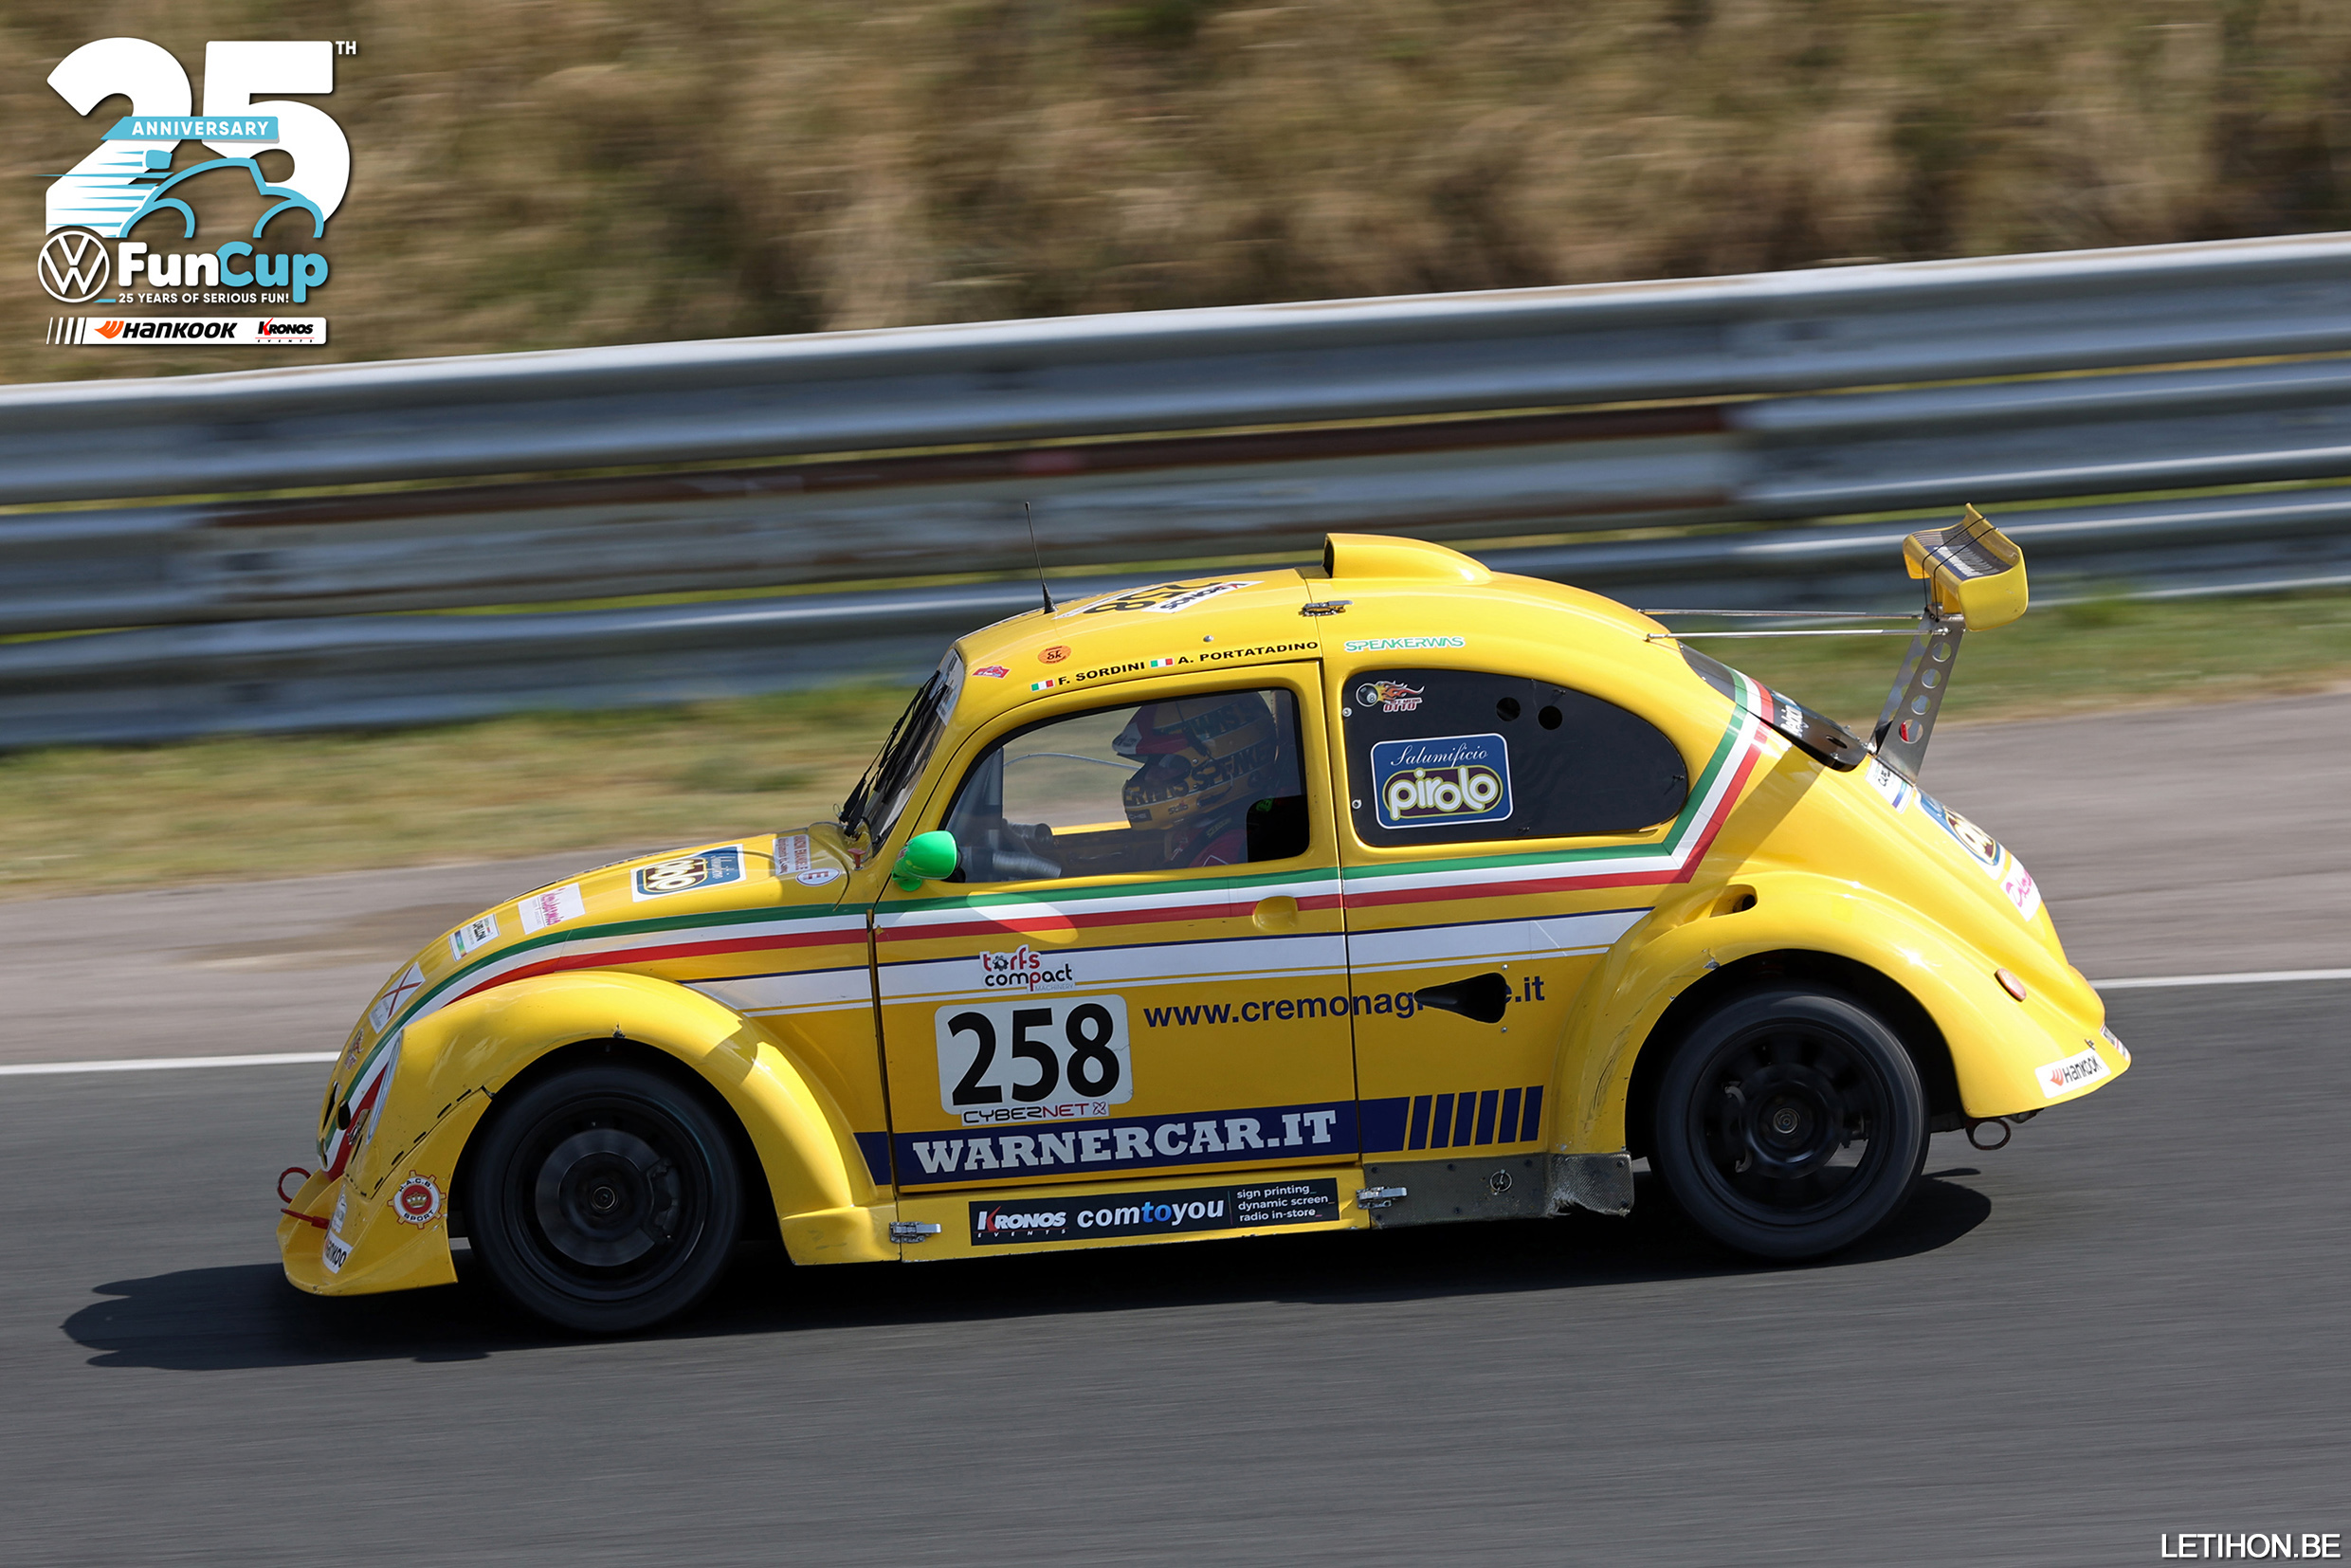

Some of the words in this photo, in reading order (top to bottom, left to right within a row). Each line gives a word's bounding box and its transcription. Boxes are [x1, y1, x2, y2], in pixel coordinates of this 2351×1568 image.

[1058, 676, 1070, 685] F.
[1076, 662, 1145, 682] SORDINI
[1177, 656, 1194, 665] A.
[1199, 641, 1319, 662] PORTATADINO
[1390, 742, 1489, 769] Salumificio
[1390, 766, 1498, 819] pirolo
[982, 947, 1041, 972] torfs
[984, 963, 1073, 992] compact
[947, 1002, 1121, 1106] 258
[963, 1103, 1089, 1124] CYBERNET
[911, 1110, 1337, 1175] WARNERCAR.IT
[1236, 1189, 1261, 1200] sign
[1238, 1198, 1288, 1212] dynamic
[403, 1210, 434, 1222] SPORT
[977, 1205, 1067, 1231] KRONOS
[1077, 1197, 1225, 1229] comtoyou
[1239, 1211, 1269, 1222] radio
[977, 1229, 1066, 1238] EVENTS
